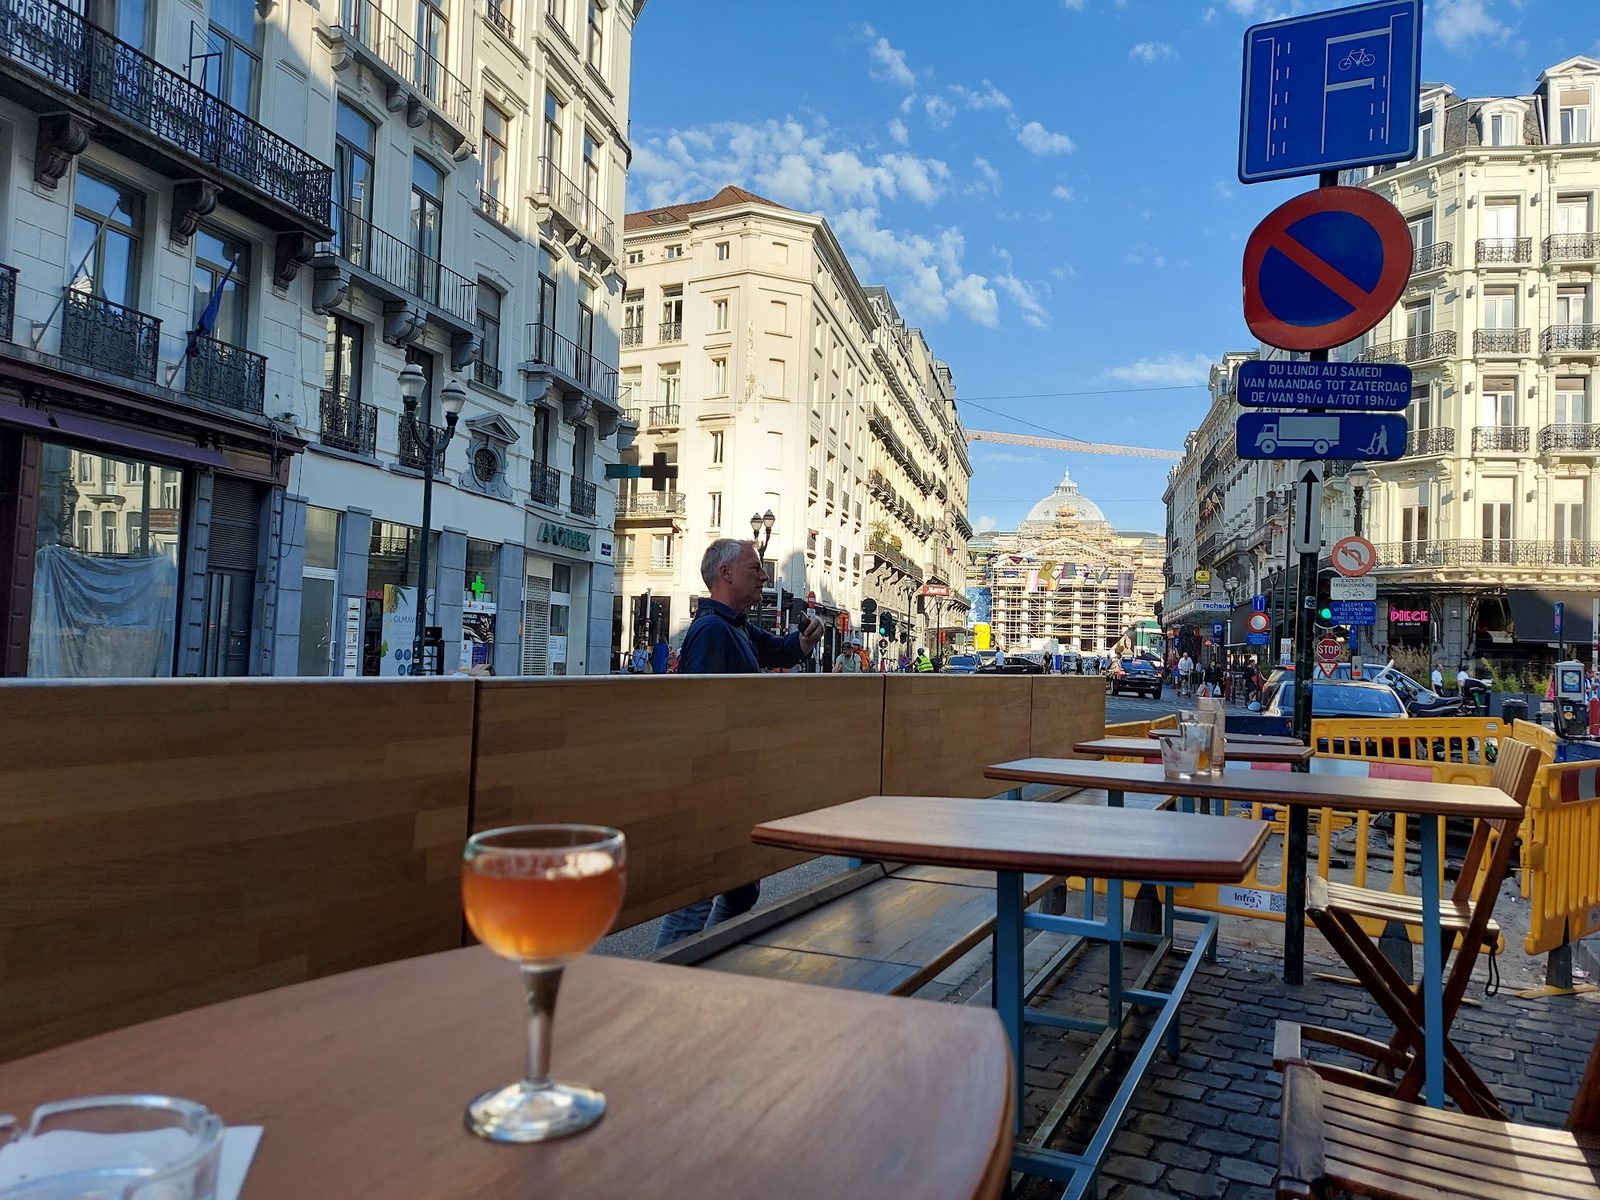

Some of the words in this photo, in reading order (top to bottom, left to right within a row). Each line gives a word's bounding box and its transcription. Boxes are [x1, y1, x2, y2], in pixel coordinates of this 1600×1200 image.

[1269, 364, 1284, 375] DU
[1287, 365, 1319, 376] LUNDI
[1321, 366, 1337, 377] AU
[1340, 366, 1382, 378] SAMEDI
[1243, 377, 1265, 388] VAN
[1268, 378, 1322, 390] MAANDAG
[1325, 379, 1346, 391] TOT
[1349, 380, 1408, 393] ZATERDAG
[1251, 391, 1294, 403] DE/VAN
[1297, 392, 1323, 404] 9h/u
[1326, 394, 1361, 405] A/TOT
[1365, 395, 1397, 406] 19h/u
[1318, 645, 1340, 656] STOP
[1234, 892, 1256, 903] Infra
